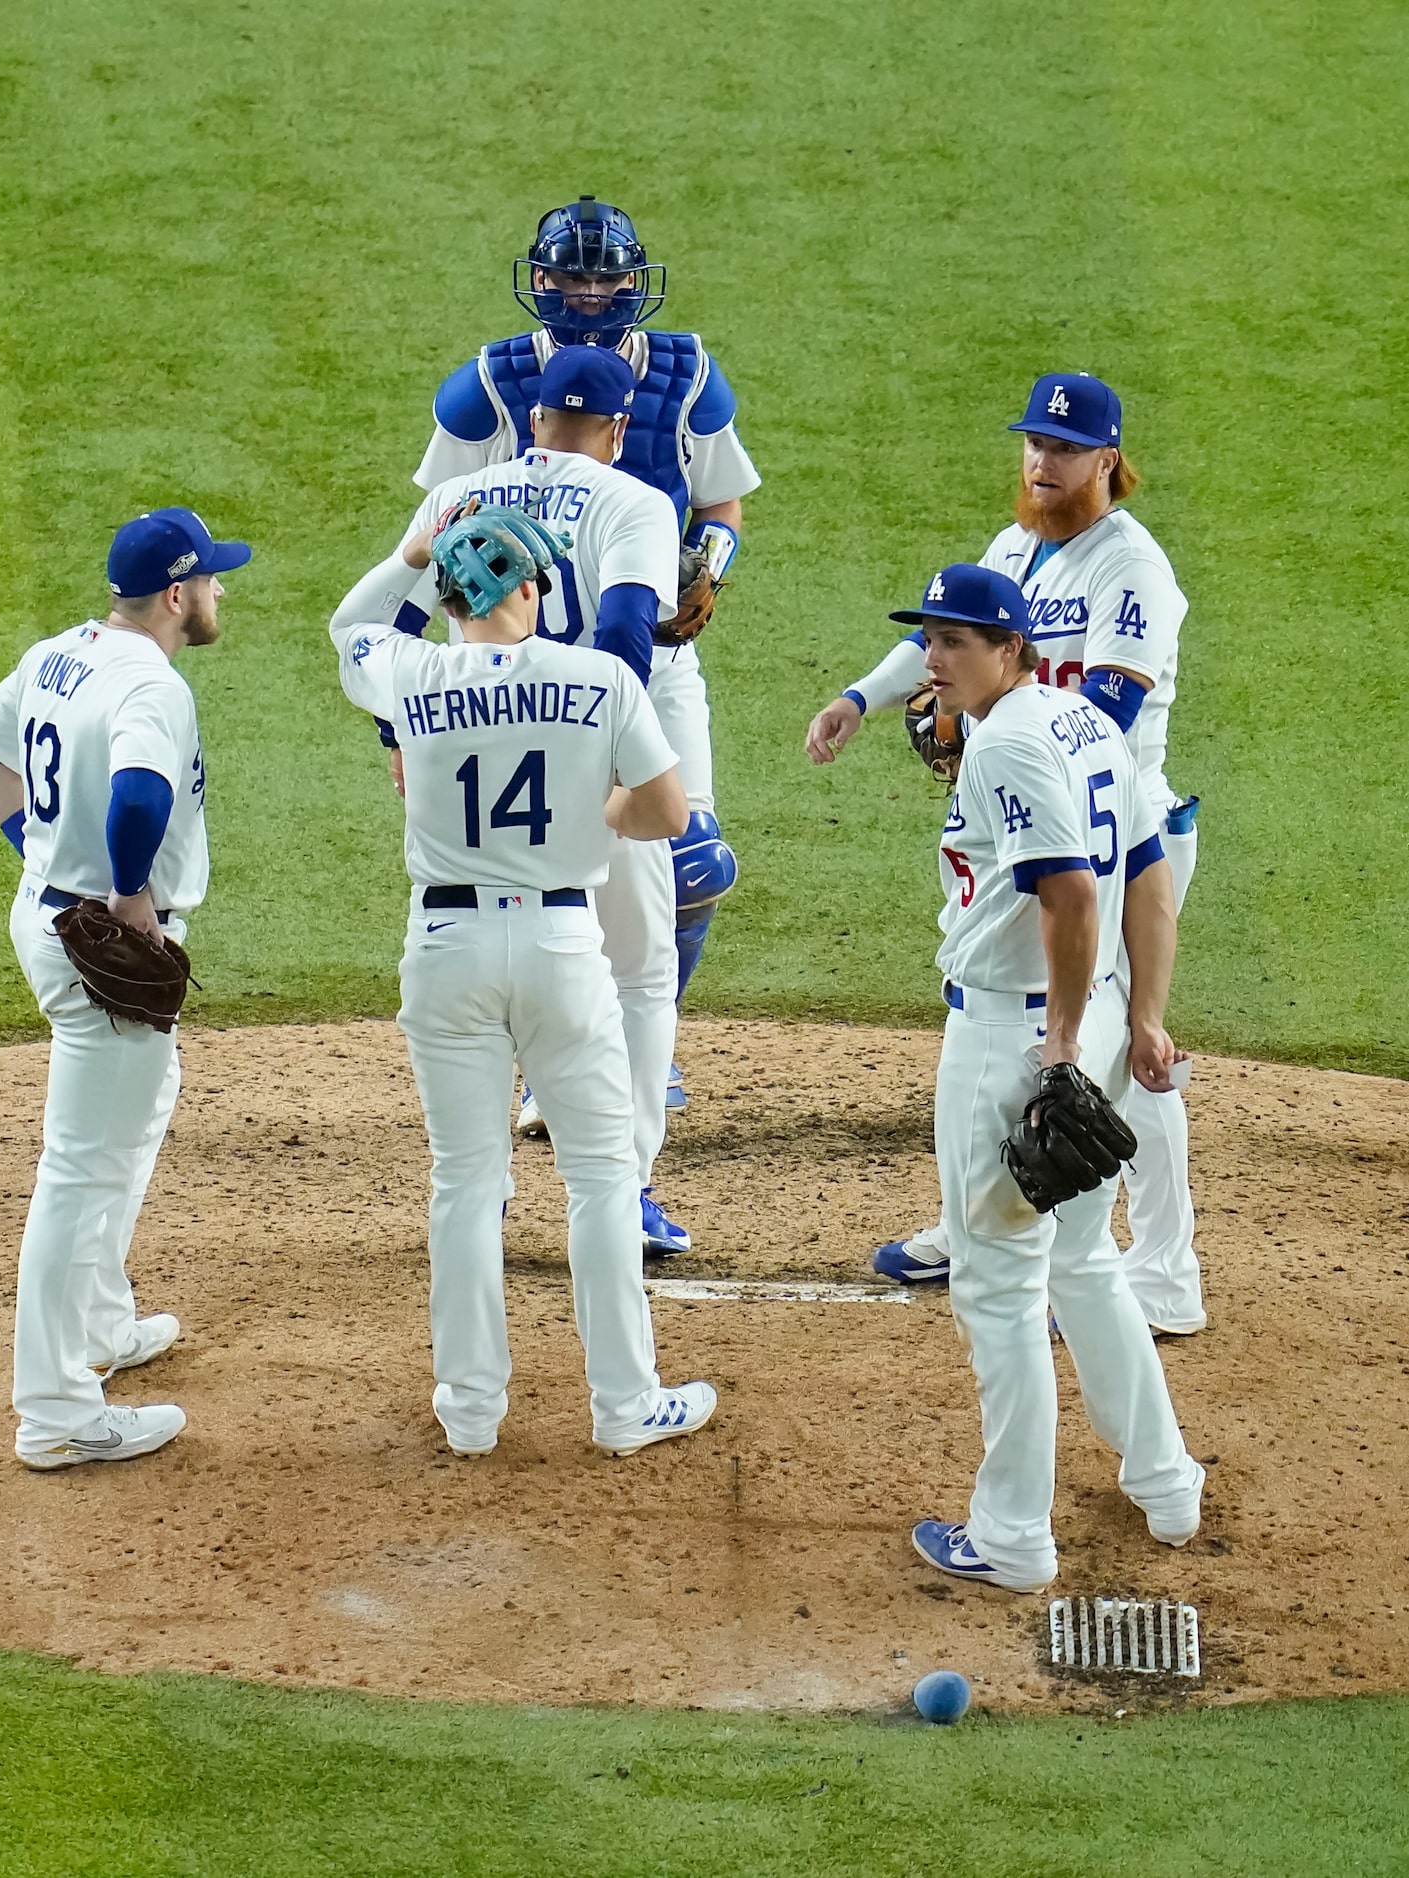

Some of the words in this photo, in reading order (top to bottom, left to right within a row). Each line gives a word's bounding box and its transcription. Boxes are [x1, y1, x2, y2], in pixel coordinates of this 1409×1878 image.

[1048, 385, 1069, 416] LA
[927, 573, 945, 601] LA
[1115, 589, 1147, 640] LA
[32, 651, 94, 701] MUNCY
[24, 717, 61, 824] 13
[456, 749, 552, 848] 14
[994, 785, 1032, 834] LA
[1087, 769, 1118, 878] 5
[941, 847, 975, 908] 5
